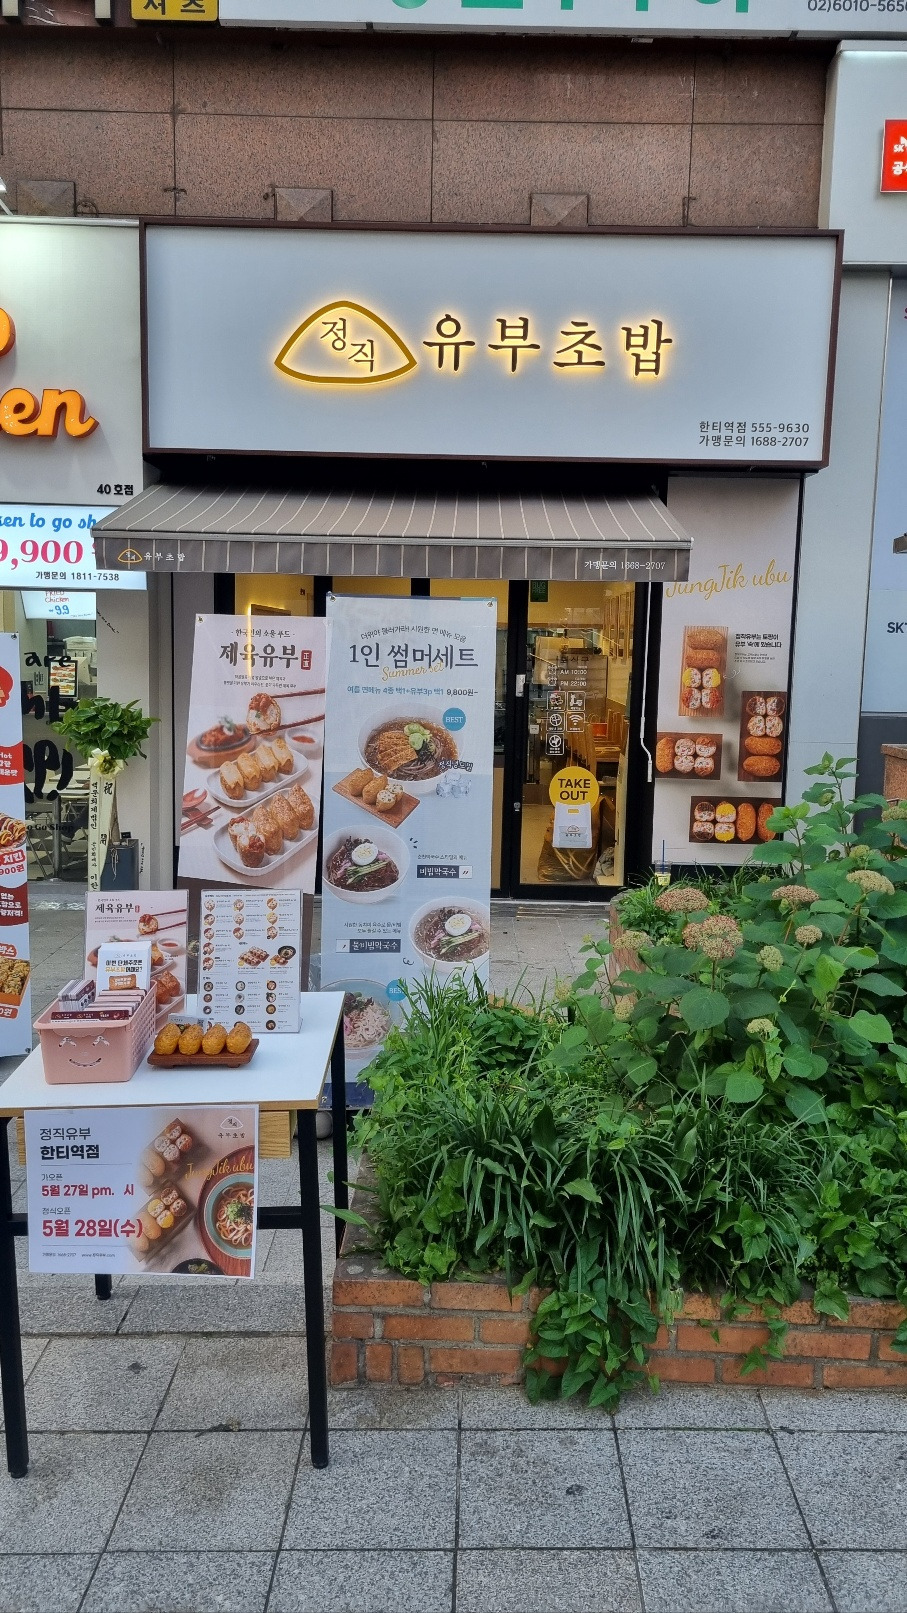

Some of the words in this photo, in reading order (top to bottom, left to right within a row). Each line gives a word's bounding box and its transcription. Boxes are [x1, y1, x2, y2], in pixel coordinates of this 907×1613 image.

[807, 0, 907, 12] 02)6010-565
[892, 161, 907, 175] 공
[320, 317, 375, 373] 정직
[422, 313, 674, 378] 유부초밥
[699, 421, 747, 434] 한티역점
[751, 422, 810, 433] 555-9630
[699, 435, 746, 447] 가맹문의
[751, 436, 809, 447] 1688-2707
[97, 484, 111, 495] 40
[113, 484, 134, 496] 호점
[30, 512, 46, 528] to
[52, 517, 73, 533] go
[78, 513, 97, 529] sh
[36, 571, 67, 581] 가맹문의
[71, 572, 120, 582] 1811-7538
[219, 641, 299, 669] 제육유부
[349, 642, 380, 668] 1인
[387, 642, 478, 670] 썸머세트
[381, 666, 427, 681] Summer
[558, 778, 591, 789] TAKE
[560, 791, 588, 801] OUT
[40, 1127, 91, 1141] 정직유부
[40, 1144, 100, 1160] 한티역점
[42, 1173, 63, 1181] 가오픈
[42, 1185, 60, 1197] 5월
[63, 1184, 89, 1196] 27일
[92, 1186, 114, 1199] pm.
[123, 1184, 134, 1196] 시
[42, 1206, 71, 1215] 정식오픈
[42, 1219, 69, 1237] 5월
[74, 1218, 143, 1238] 28일(수)
